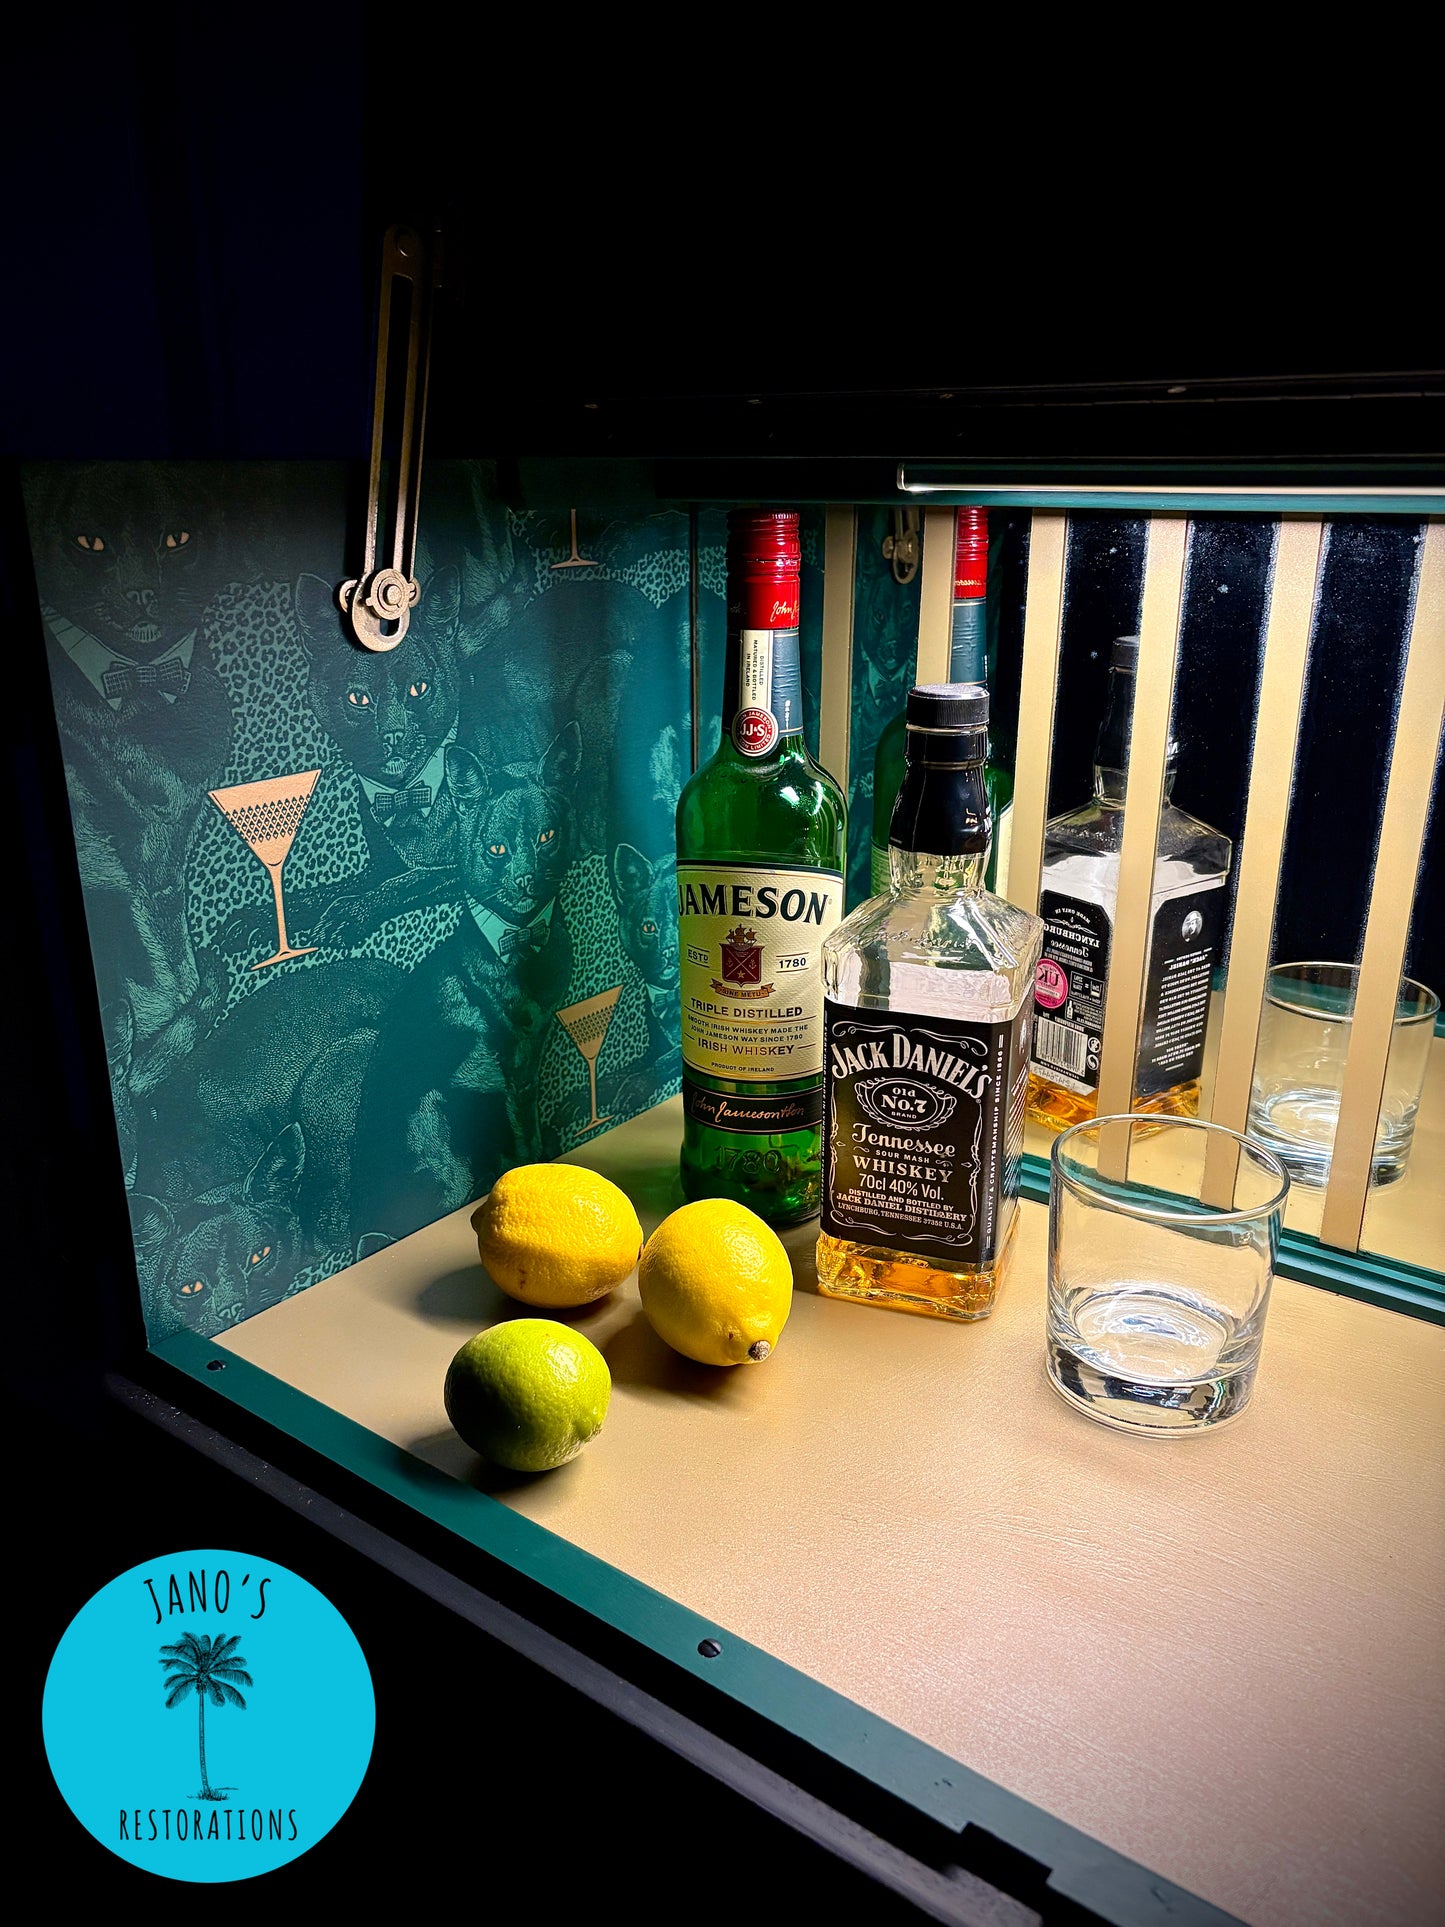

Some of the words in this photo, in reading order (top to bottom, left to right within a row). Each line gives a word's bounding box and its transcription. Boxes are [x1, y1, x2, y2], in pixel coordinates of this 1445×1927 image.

[678, 884, 828, 925] JAMESON
[779, 957, 806, 969] 1780
[691, 998, 729, 1016] TRIPLE
[734, 1007, 802, 1018] DISTILLED
[688, 1014, 709, 1028] SMOOTH
[711, 1023, 730, 1032] IRISH
[691, 1025, 704, 1035] JOHN
[705, 1030, 738, 1041] JAMESON
[698, 1037, 728, 1052] IRISH
[732, 1045, 794, 1056] WHISKEY
[711, 1062, 736, 1072] PRODUCT
[830, 1042, 890, 1079] JACK
[892, 1033, 992, 1099] DANIEL'S
[881, 1094, 927, 1113] No.7
[892, 1086, 916, 1097] Old
[691, 1092, 715, 1114] John
[715, 1101, 780, 1122] Jameson
[891, 1111, 917, 1119] BRAND
[852, 1122, 955, 1157] Tennessee
[990, 1106, 999, 1184] CRAFTSMANSHIP
[714, 1146, 780, 1174] 1780
[876, 1149, 900, 1159] SOUR
[904, 1154, 930, 1163] MASH
[852, 1155, 953, 1183] WHISKEY
[859, 1173, 886, 1190] 70cl
[889, 1179, 918, 1196] 40%
[921, 1183, 944, 1200] Vol.
[837, 1192, 862, 1204] JACK
[864, 1197, 902, 1211] DANIEL
[905, 1203, 968, 1222] DISTILLERY
[848, 1188, 886, 1200] DISTILLED
[888, 1195, 904, 1204] AND
[906, 1197, 941, 1210] BOTTLED
[943, 1204, 954, 1212] BY
[838, 1202, 880, 1216] LYNCHBURG,
[881, 1210, 922, 1223] TENNESSEE
[923, 1218, 943, 1226] 37352
[944, 1220, 964, 1230] U.S.A.
